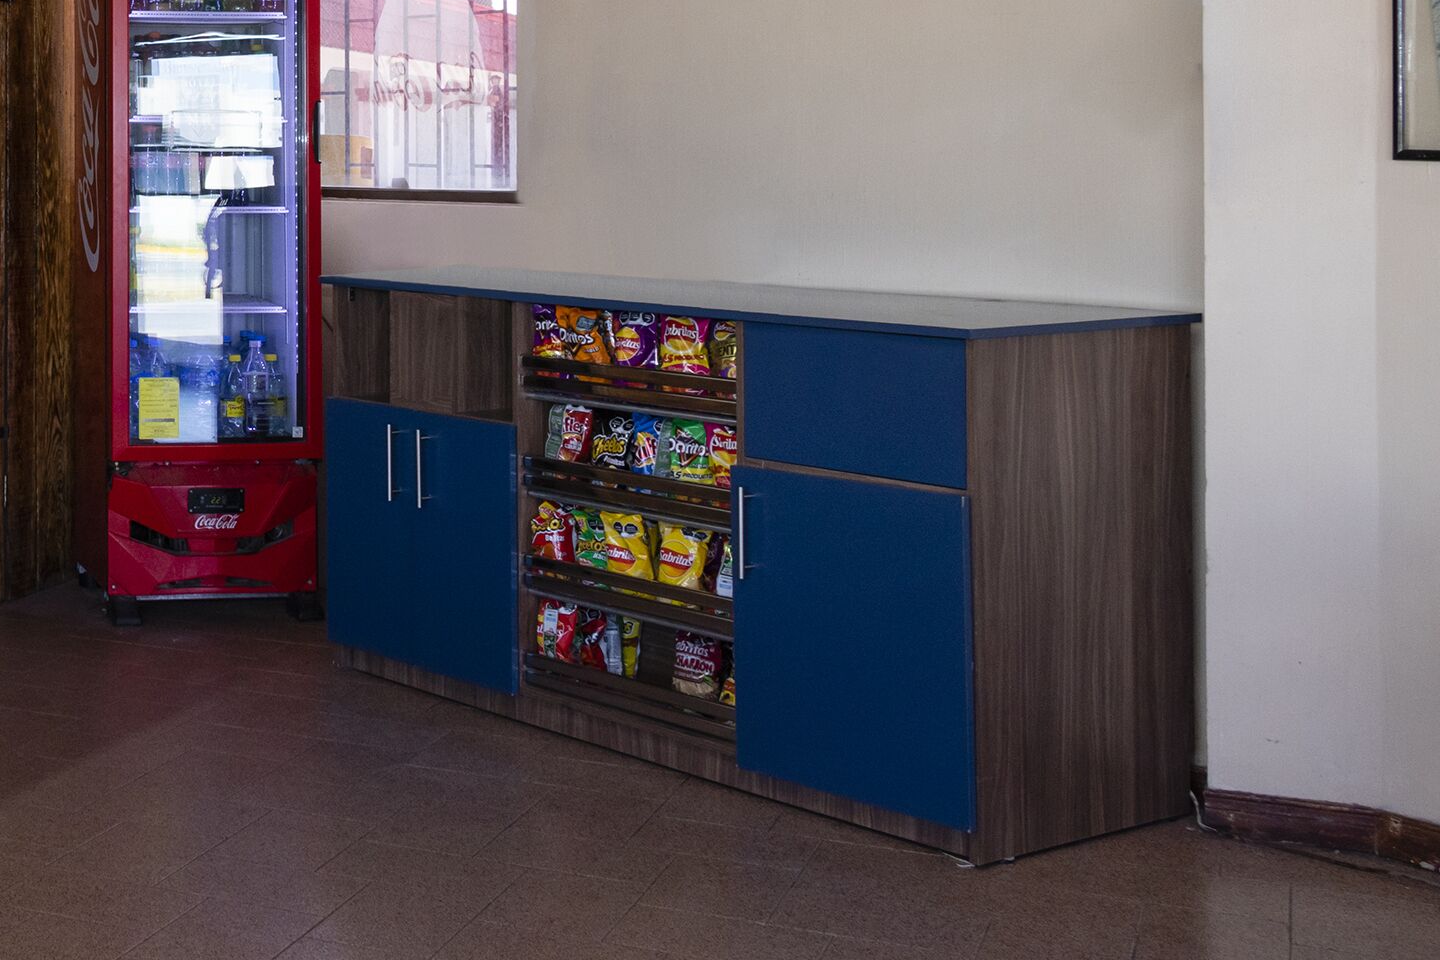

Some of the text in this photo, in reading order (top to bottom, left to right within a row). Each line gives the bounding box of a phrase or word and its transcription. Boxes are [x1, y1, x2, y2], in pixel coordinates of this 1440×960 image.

[669, 438, 710, 456] Dorito
[194, 514, 239, 530] Coca-Cola
[675, 641, 709, 657] abritas
